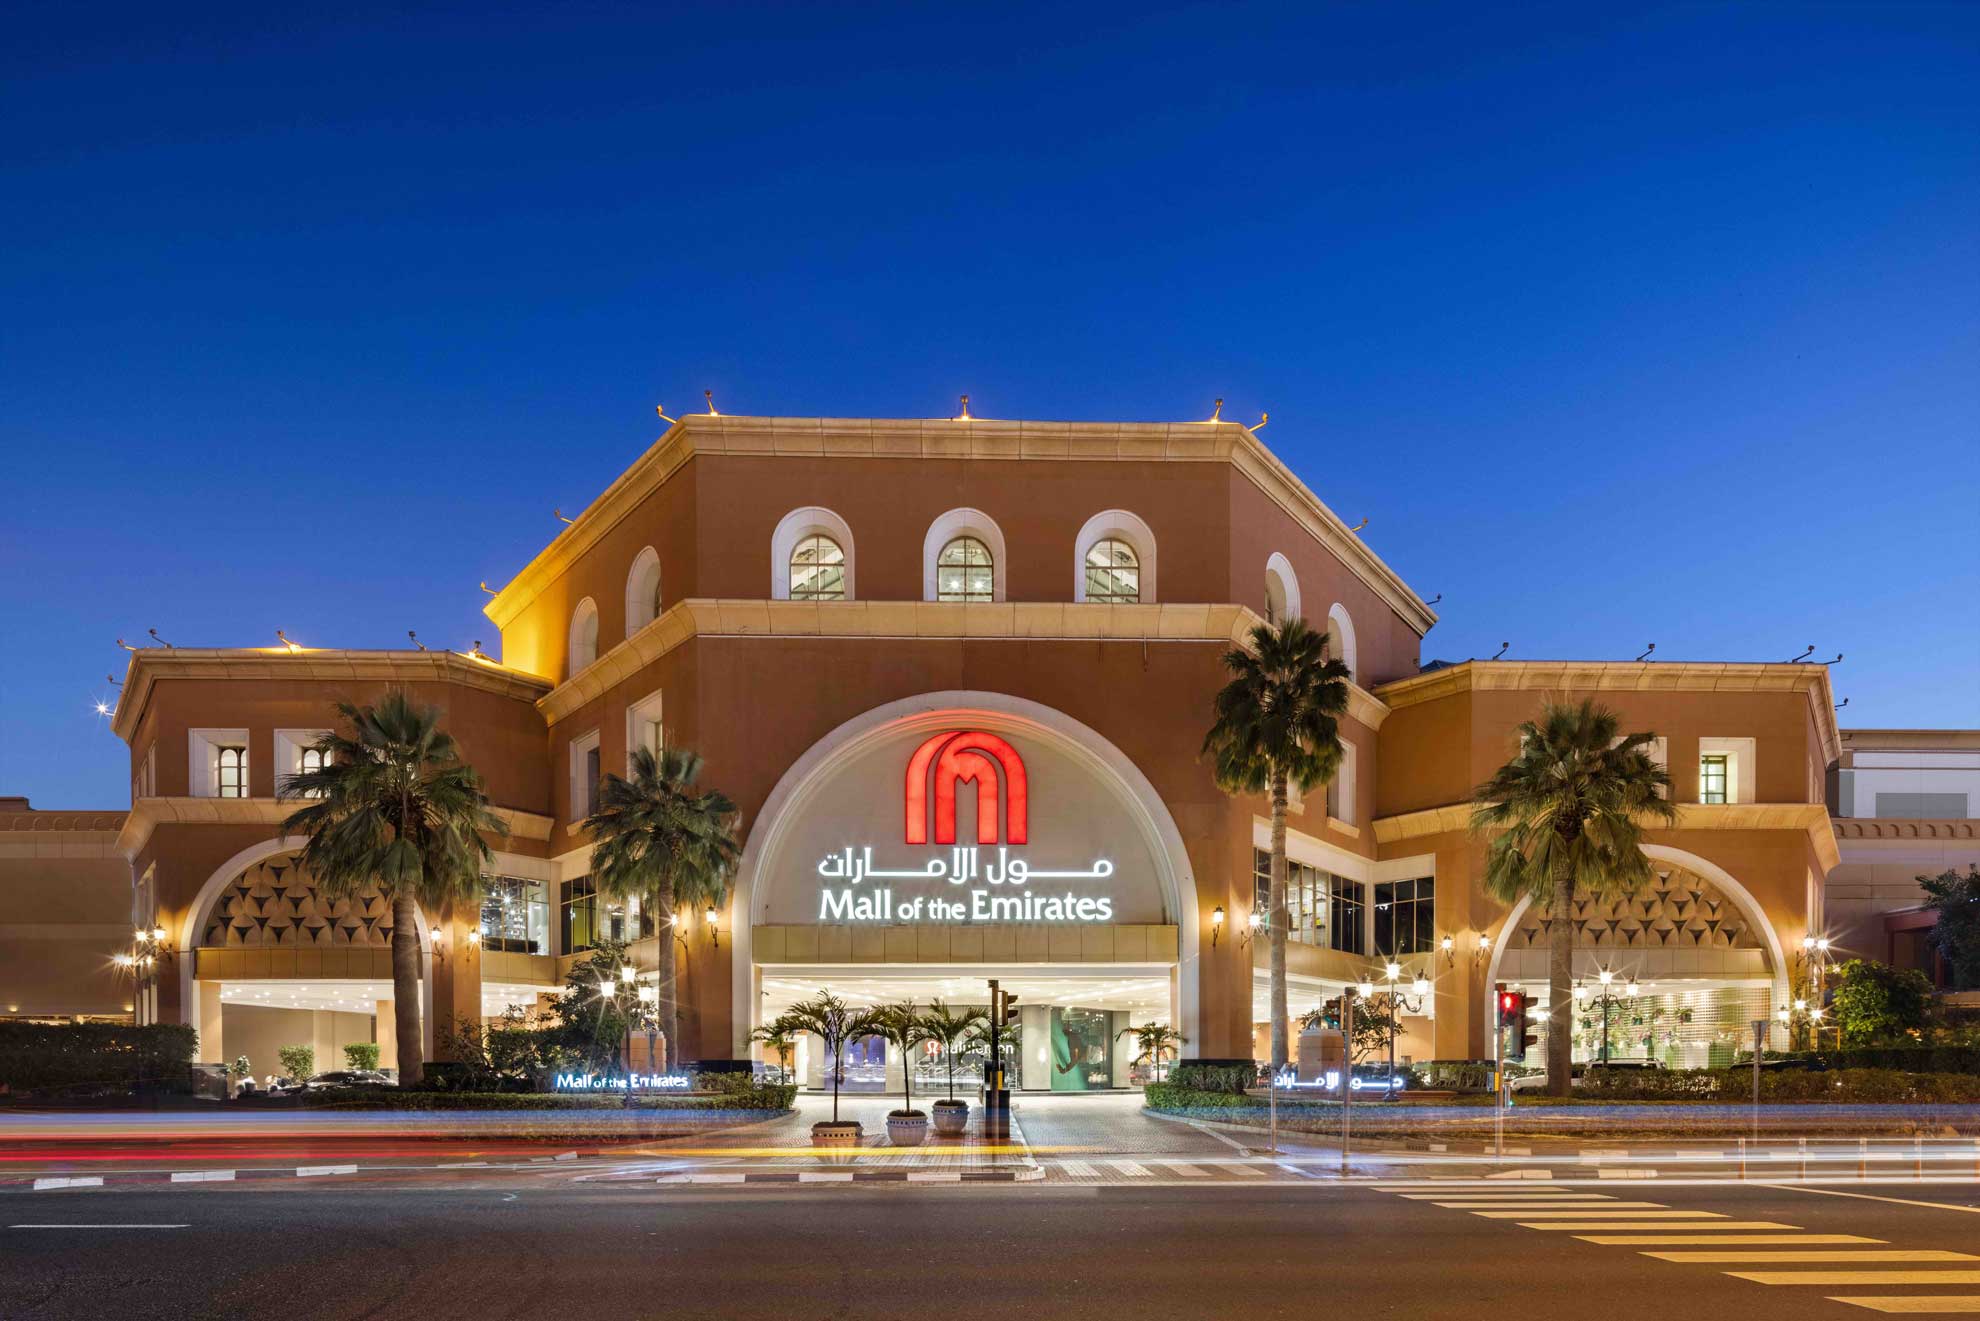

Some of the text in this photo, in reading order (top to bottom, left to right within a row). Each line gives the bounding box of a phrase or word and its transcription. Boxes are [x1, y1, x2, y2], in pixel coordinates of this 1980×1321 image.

[986, 847, 1113, 885] مول
[819, 889, 1113, 920] Mall of the Emirates
[557, 1073, 688, 1088] Mall of the Emirates
